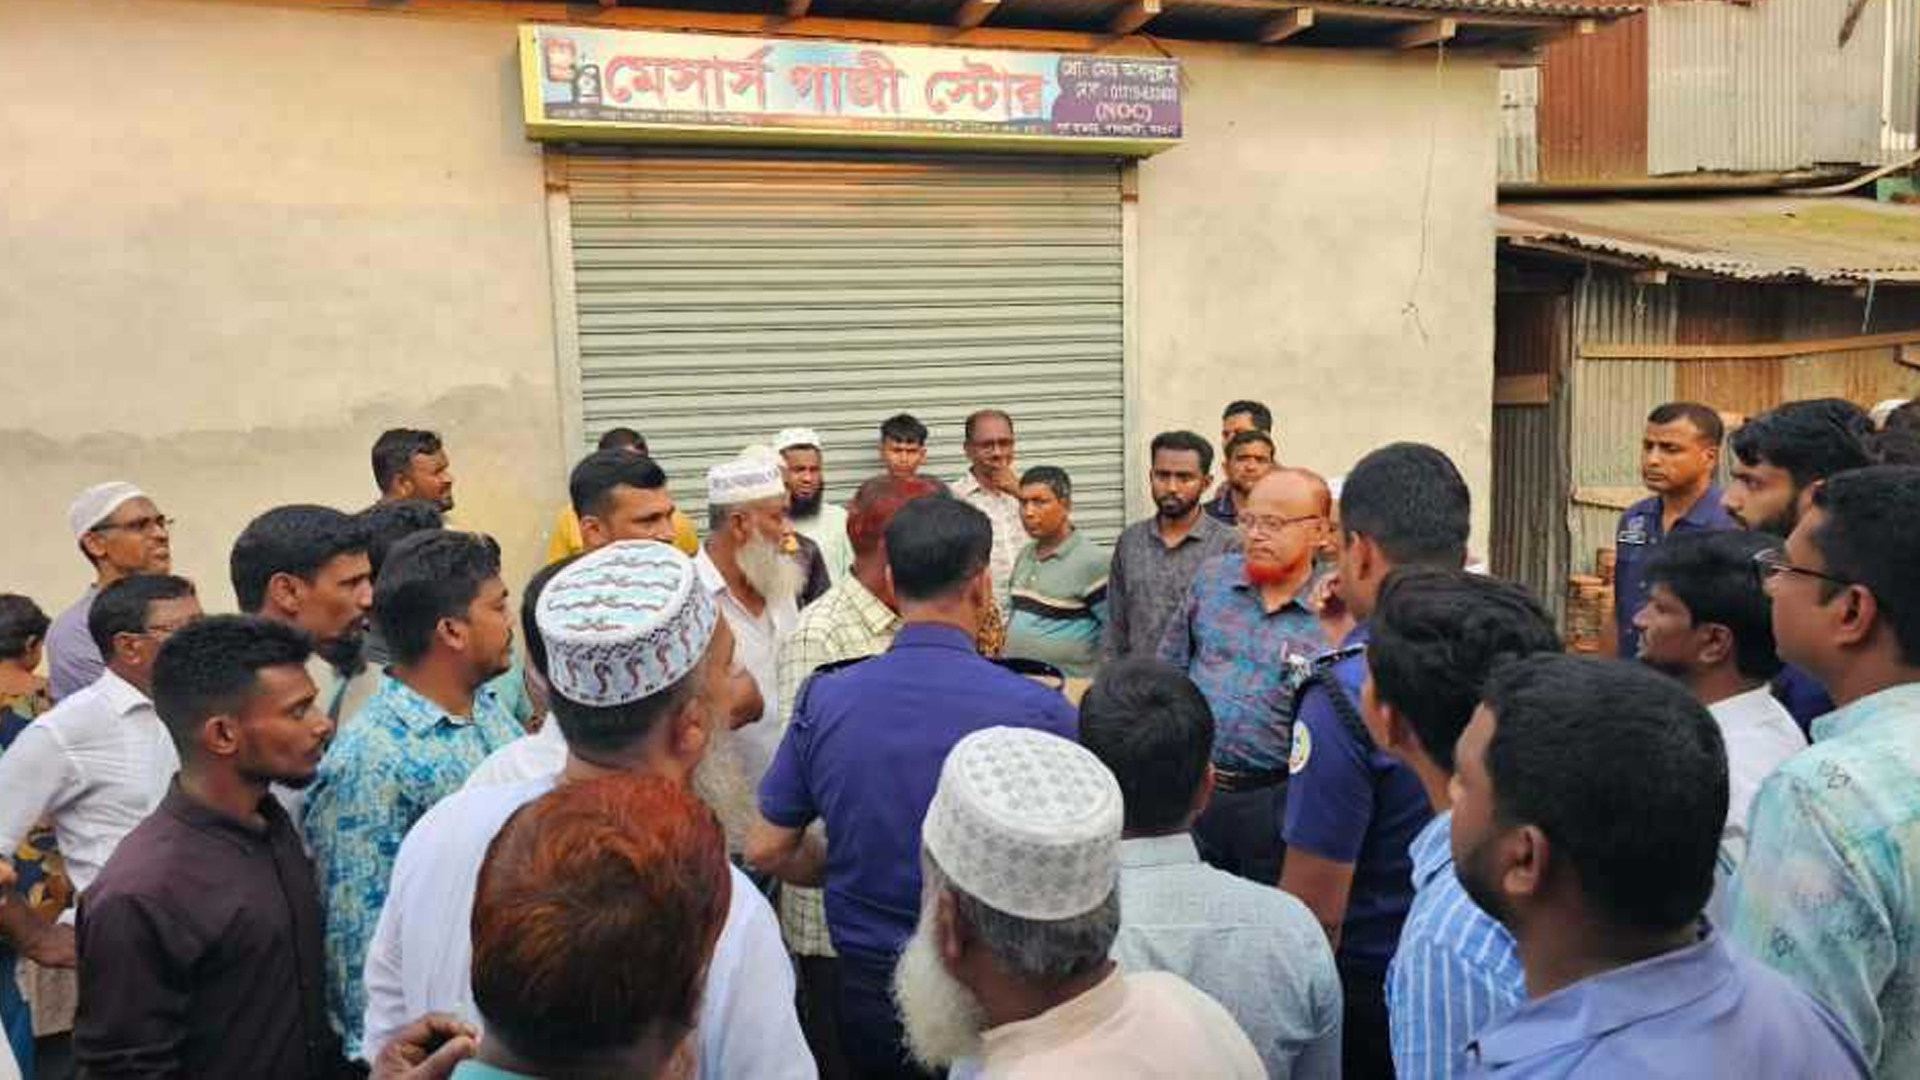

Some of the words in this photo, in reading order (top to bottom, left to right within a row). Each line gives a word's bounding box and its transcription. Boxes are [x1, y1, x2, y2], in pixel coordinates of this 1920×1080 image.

[604, 46, 774, 108] মেসার্স
[787, 50, 905, 112] গাজী
[925, 56, 1043, 114] স্টোর
[1095, 103, 1153, 123] (NOC)
